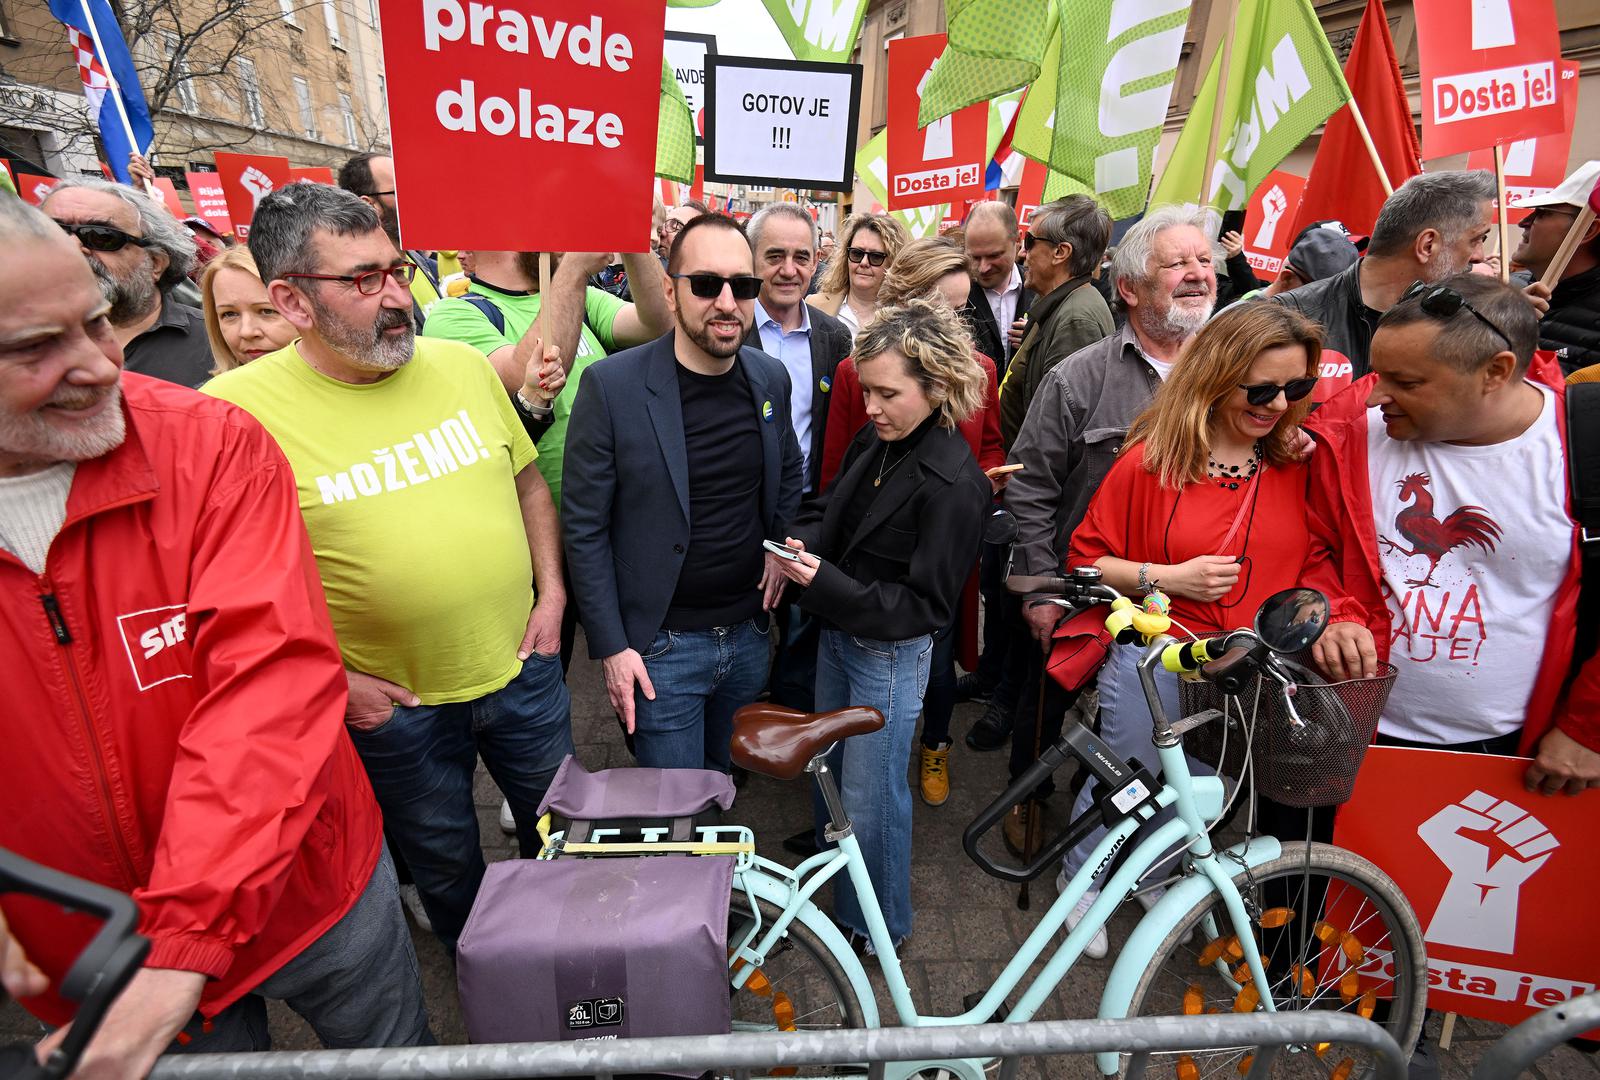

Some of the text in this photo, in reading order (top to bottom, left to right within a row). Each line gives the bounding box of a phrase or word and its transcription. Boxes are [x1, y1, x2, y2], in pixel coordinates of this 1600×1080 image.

[422, 0, 633, 73] pravde
[674, 68, 704, 84] AVDE
[1560, 70, 1576, 80] DP
[1437, 67, 1552, 119] Dosta je!
[435, 79, 624, 149] dolaze
[742, 93, 830, 117] GOTOV JE
[772, 126, 791, 149] !!!
[896, 166, 977, 194] Dosta je!
[200, 200, 228, 208] prav
[204, 209, 230, 217] dola
[1248, 256, 1264, 268] sta
[315, 409, 491, 505] MOŽEMO!
[570, 1010, 591, 1020] 20L
